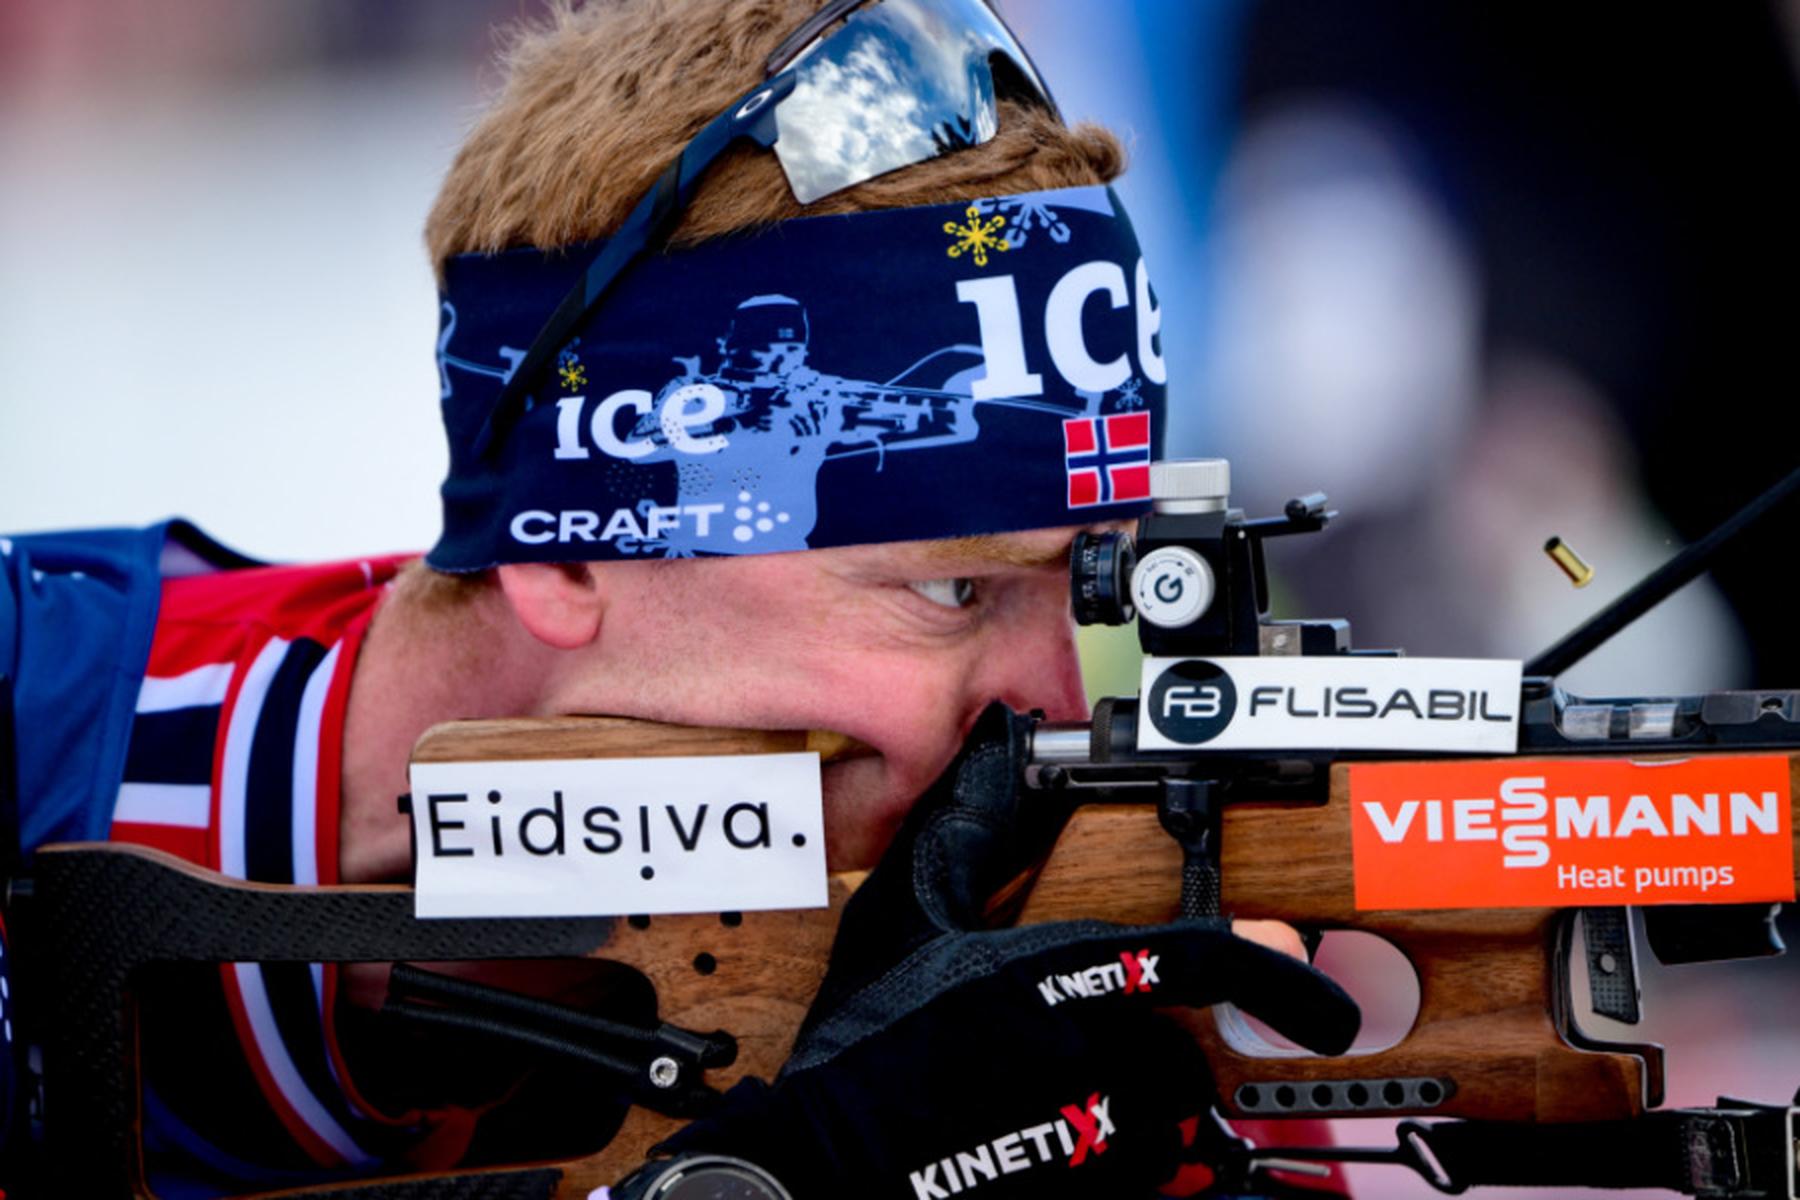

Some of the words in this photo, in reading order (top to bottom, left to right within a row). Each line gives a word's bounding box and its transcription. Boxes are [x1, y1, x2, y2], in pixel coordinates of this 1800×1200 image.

[553, 383, 730, 459] ice
[510, 503, 725, 544] CRAFT
[1249, 686, 1513, 722] FLISABIL
[1557, 864, 1627, 890] Heat
[1634, 866, 1735, 893] pumps
[1037, 948, 1160, 1006] KNETIXX
[909, 1092, 1116, 1200] KINETIXX
